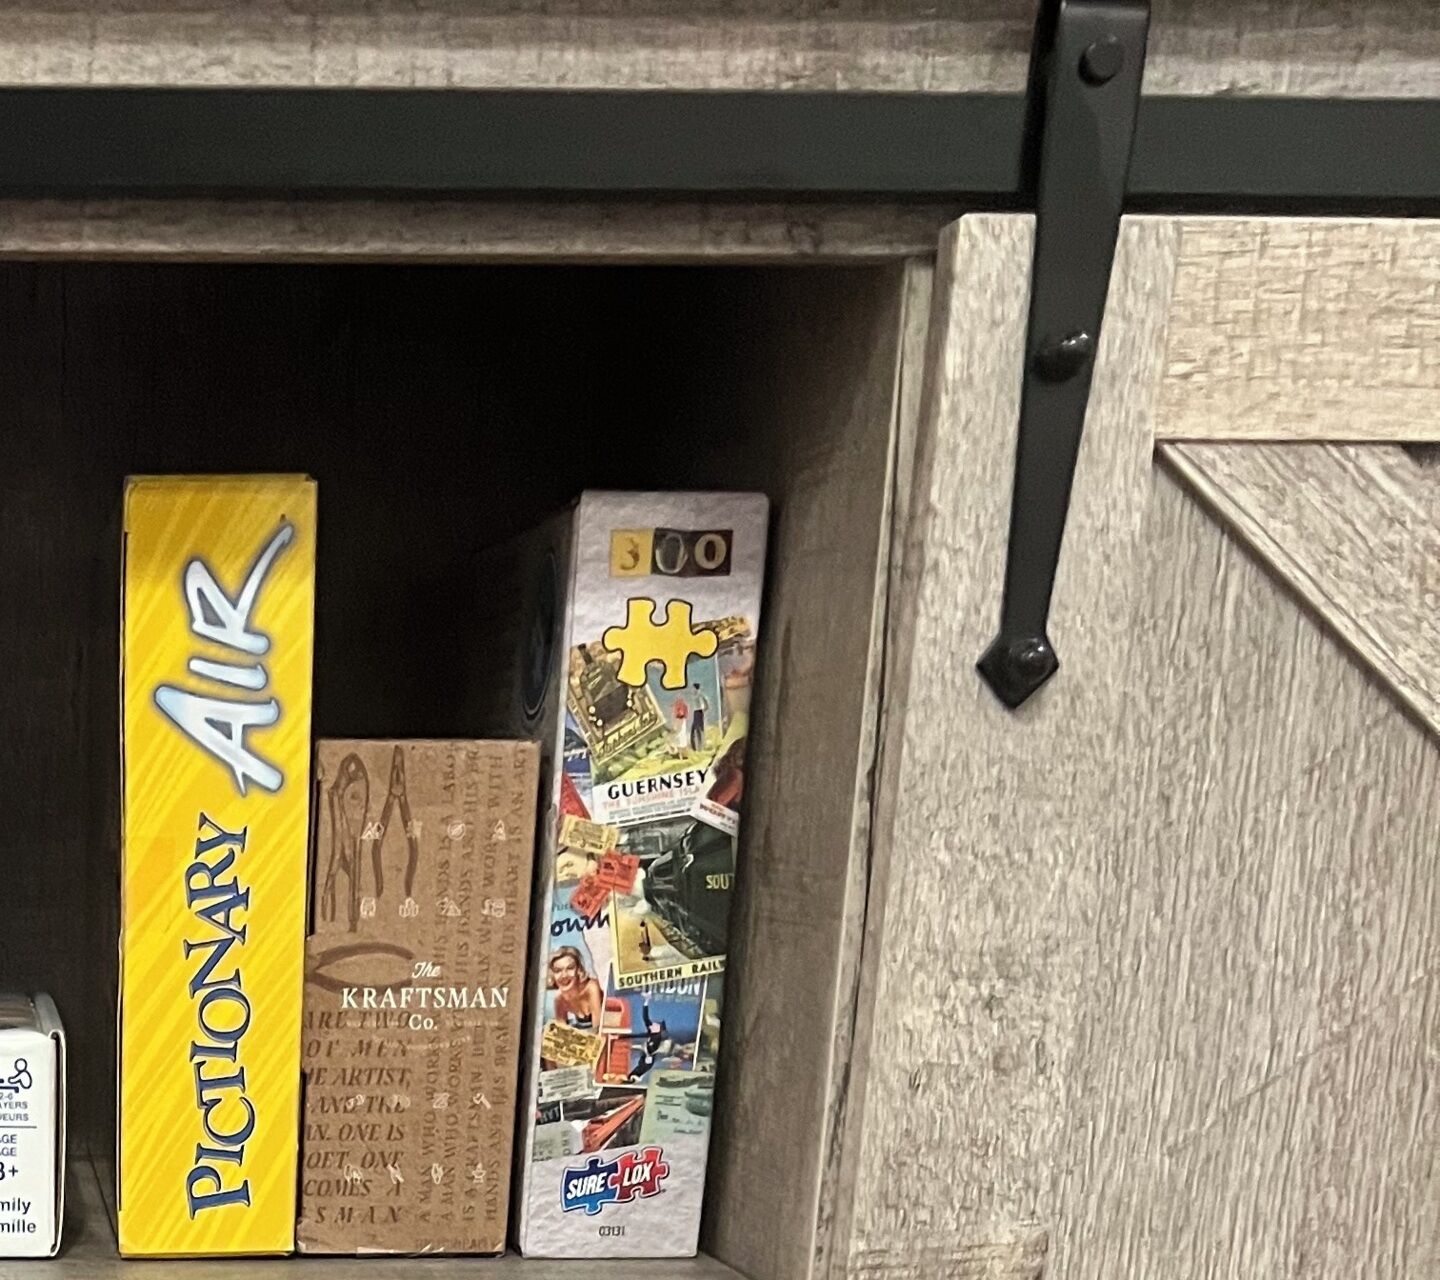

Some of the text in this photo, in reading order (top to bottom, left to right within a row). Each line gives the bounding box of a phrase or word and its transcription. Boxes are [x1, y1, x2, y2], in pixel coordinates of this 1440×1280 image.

[607, 764, 712, 800] GUERNSEY
[154, 523, 295, 1221] PICTIONARY AIR
[410, 961, 443, 979] The
[618, 966, 683, 989] SOUTHERN
[340, 987, 511, 1009] KRAFTSMAN
[408, 1014, 438, 1031] Co.
[566, 1161, 654, 1200] SURE LOX
